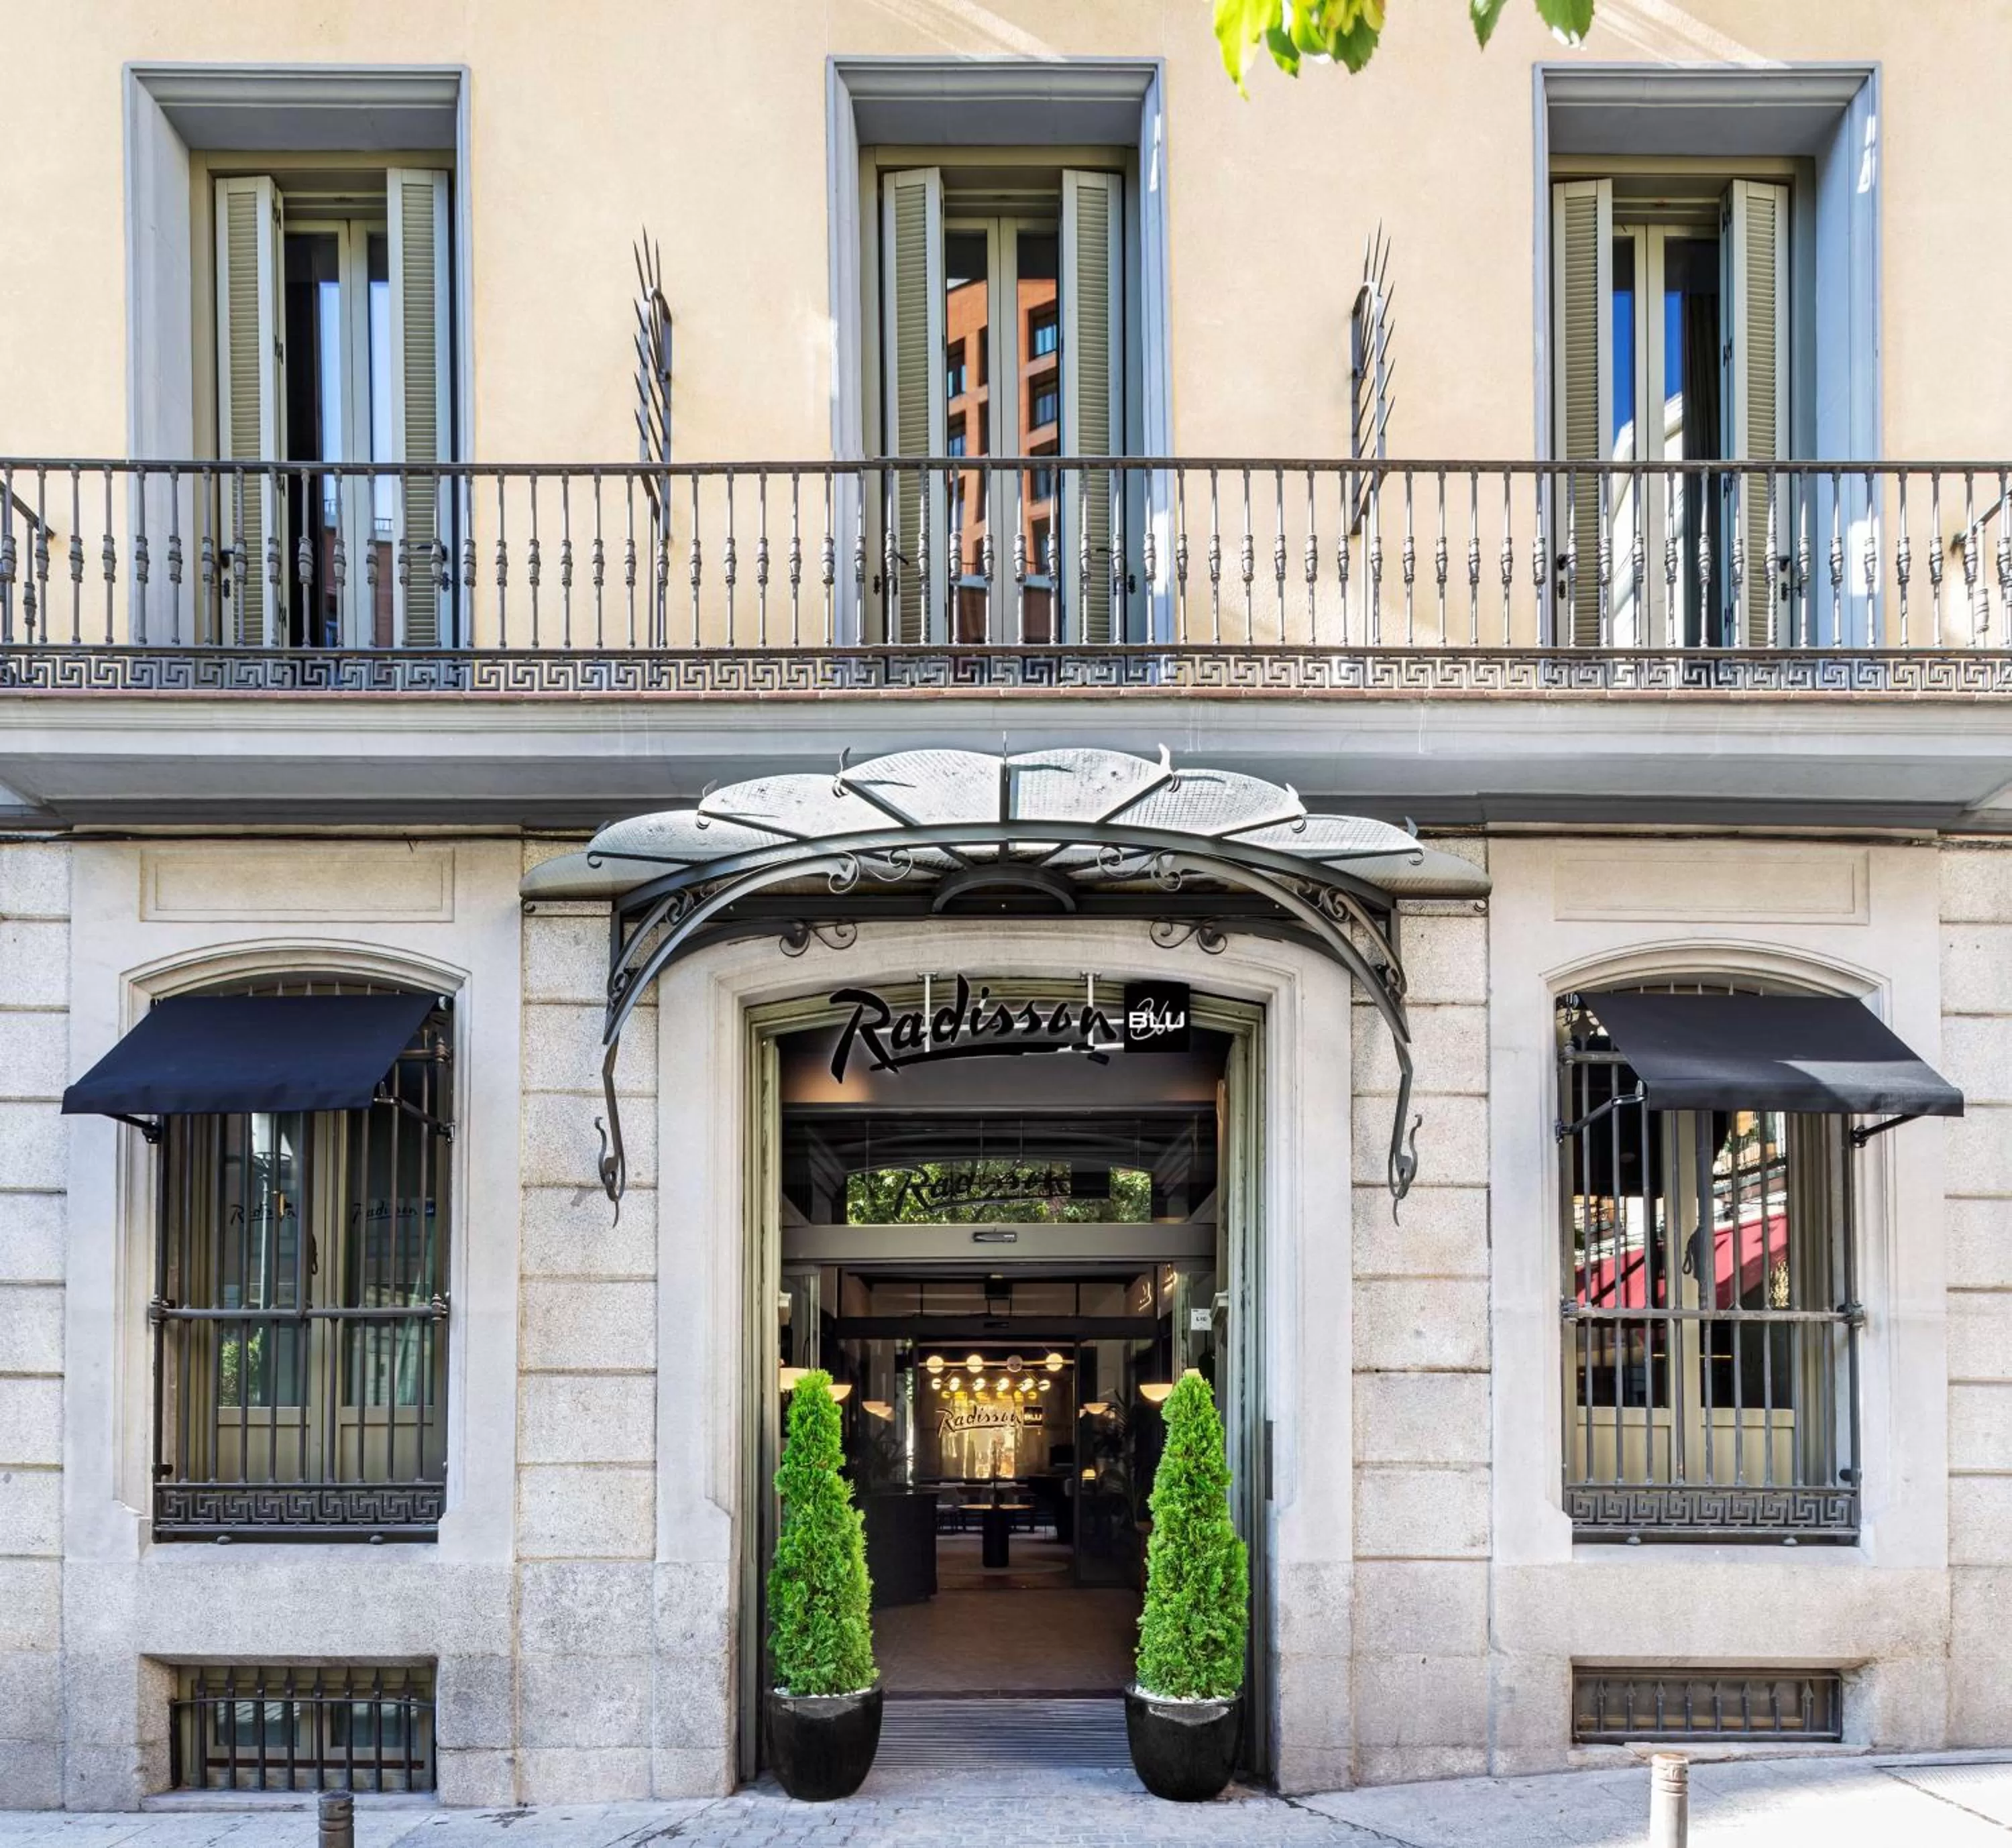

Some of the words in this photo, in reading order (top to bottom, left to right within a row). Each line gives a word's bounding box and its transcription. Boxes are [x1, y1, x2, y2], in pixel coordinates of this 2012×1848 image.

[830, 974, 1117, 1084] Radisson
[1129, 1010, 1185, 1029] BLU
[936, 1405, 1021, 1435] Radisson
